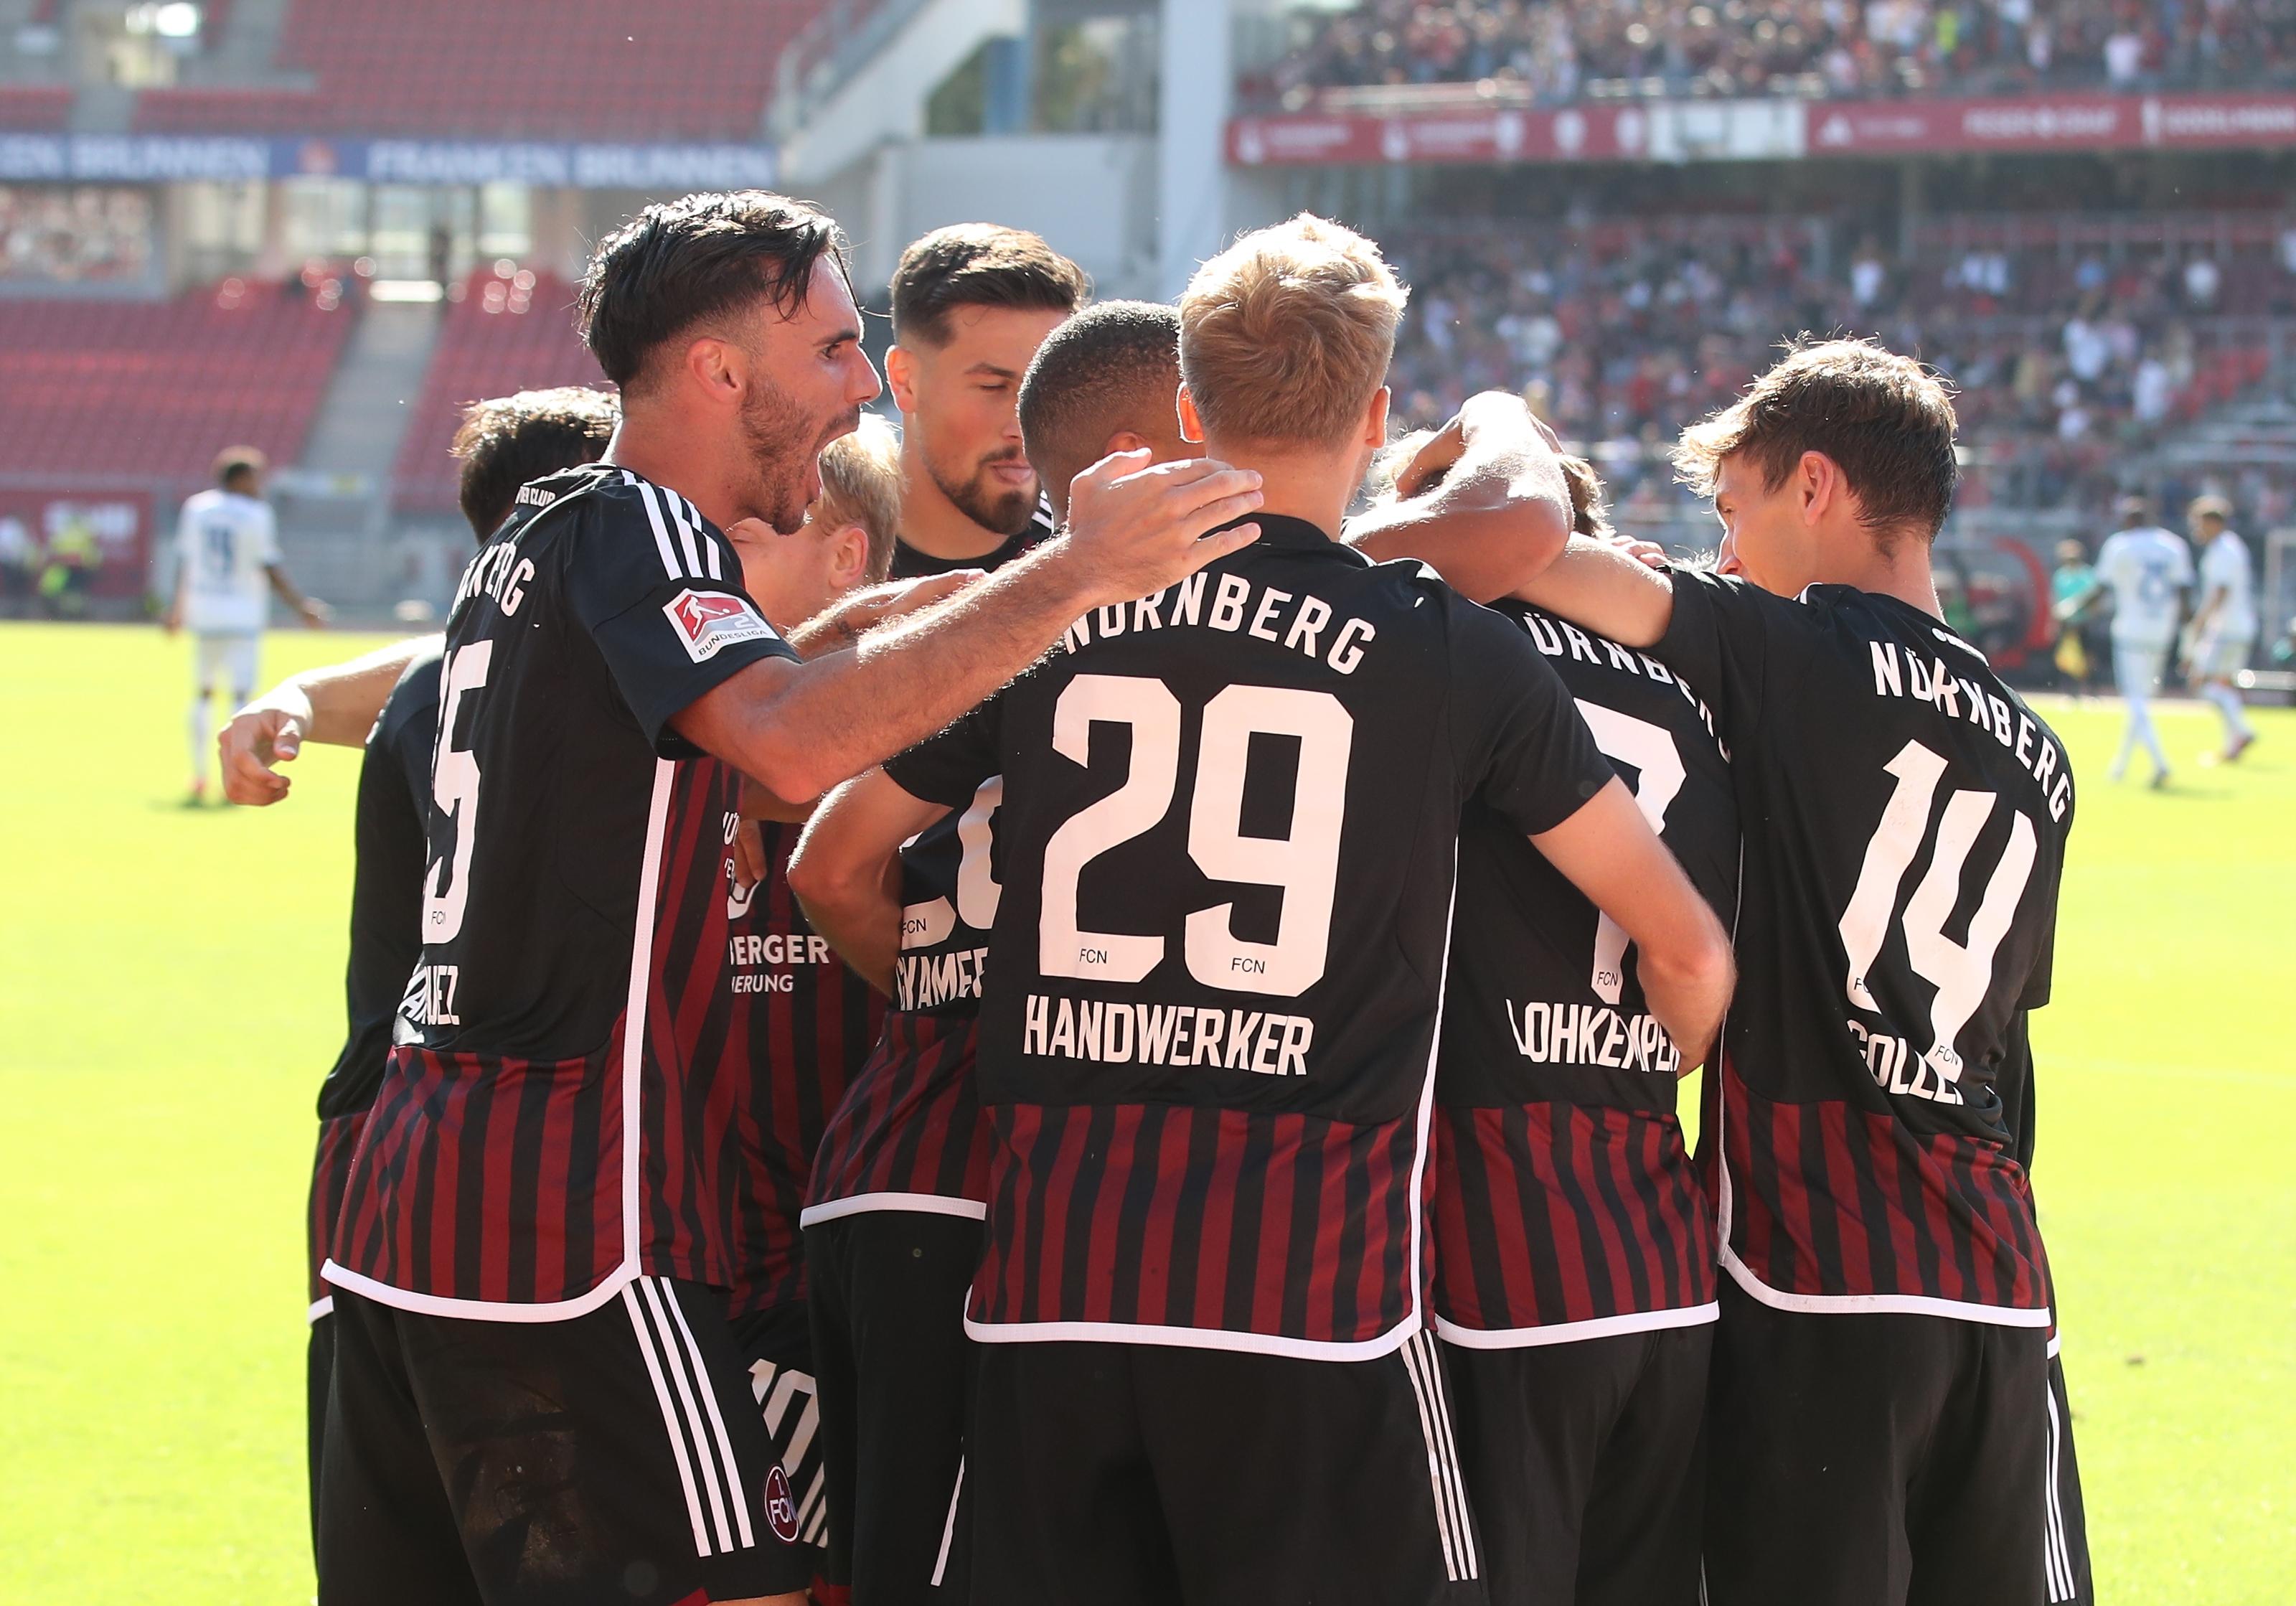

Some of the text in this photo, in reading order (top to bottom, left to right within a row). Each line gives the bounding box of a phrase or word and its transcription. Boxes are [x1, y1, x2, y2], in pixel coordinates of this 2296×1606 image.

[698, 629, 768, 656] BUNDESLIGA
[1869, 641, 2072, 823] NÜRNBERG
[1039, 673, 1355, 997] 29
[1838, 738, 2038, 1083] 14
[729, 934, 830, 966] ERGER
[1078, 948, 1108, 964] FCN
[1231, 957, 1266, 975] FCN
[1596, 971, 1619, 987] FCN
[731, 974, 794, 994] ERUNG
[1022, 993, 1314, 1076] HANDWERKER
[1934, 1045, 1959, 1066] FCN
